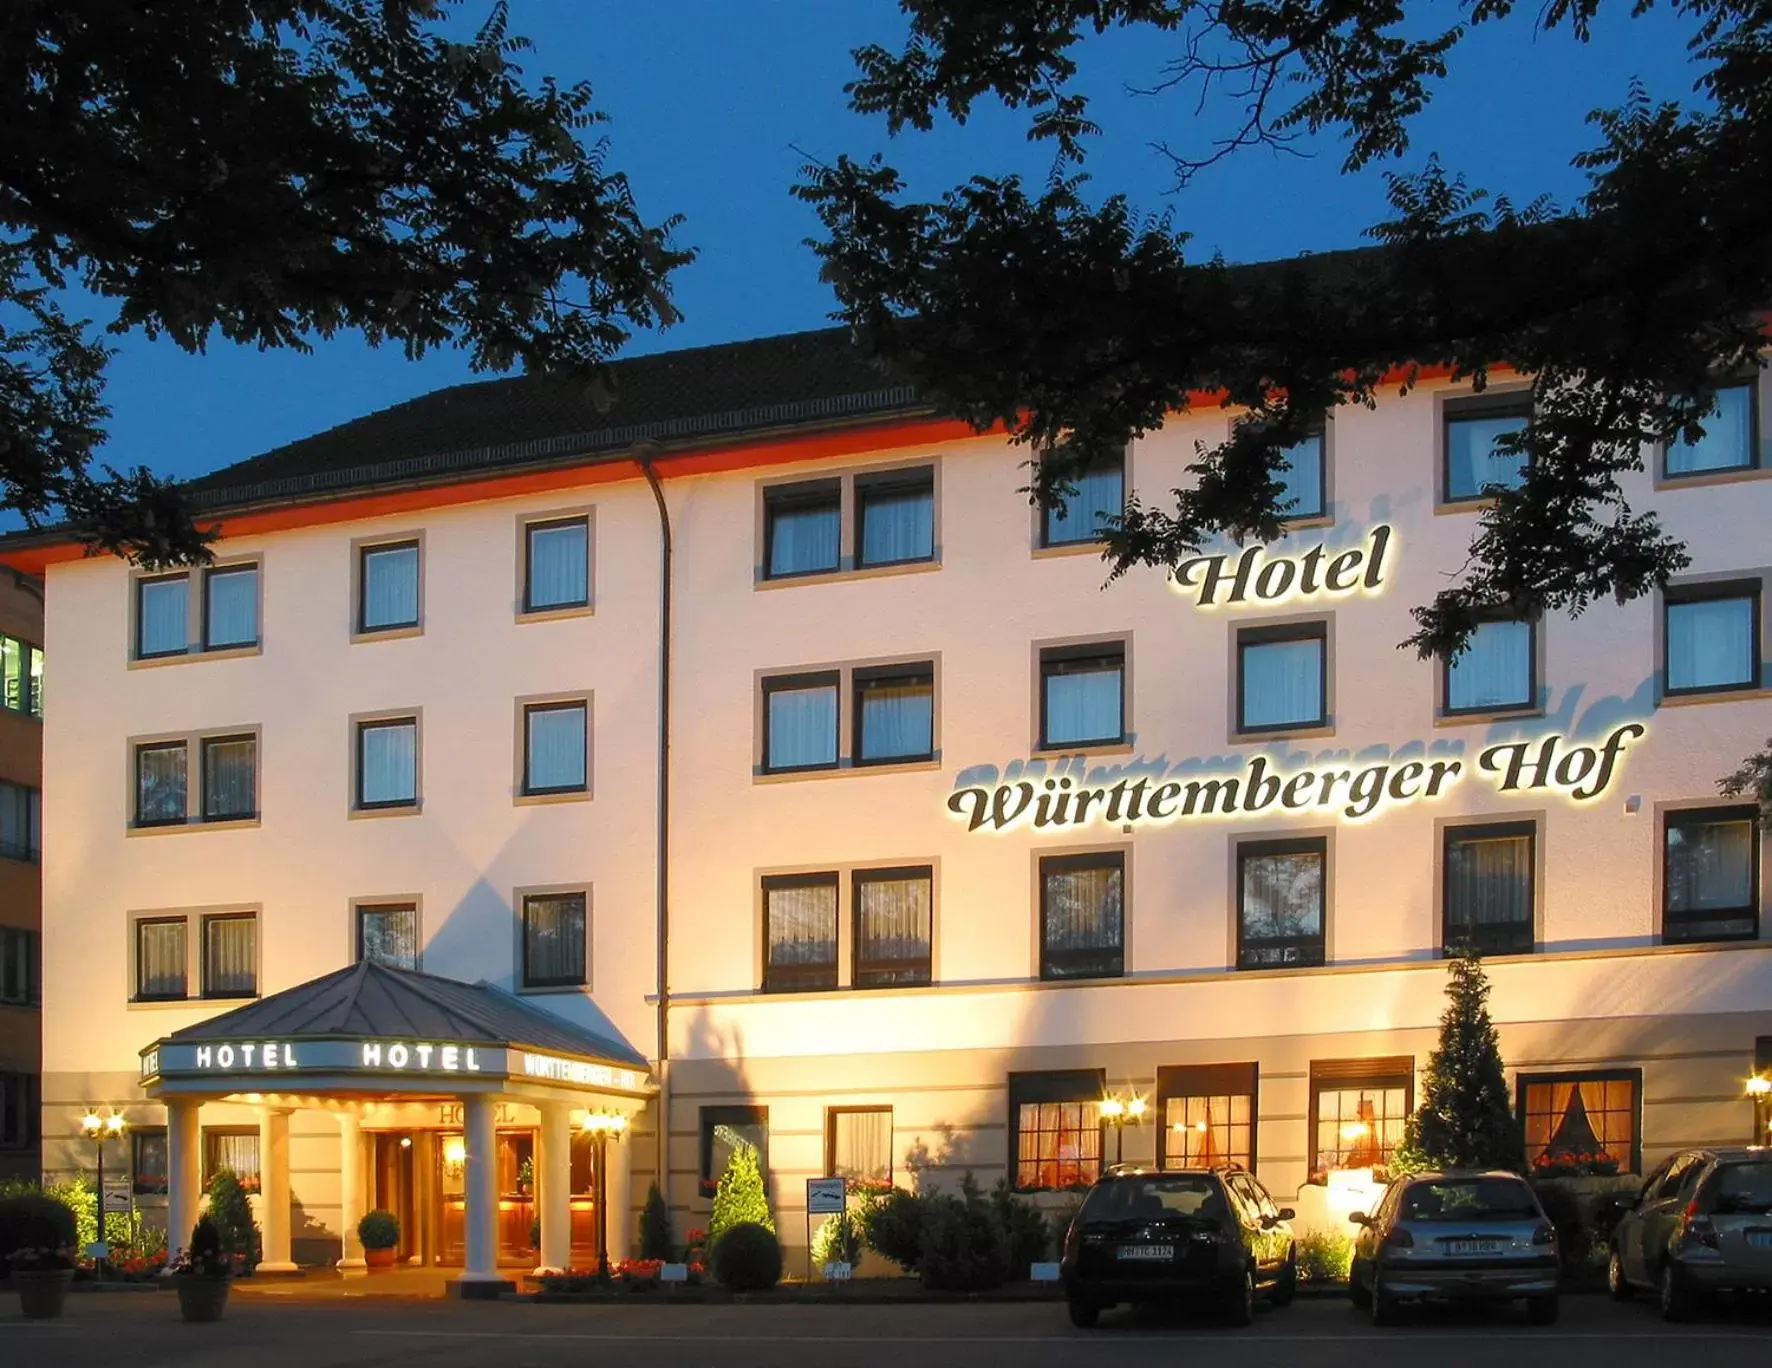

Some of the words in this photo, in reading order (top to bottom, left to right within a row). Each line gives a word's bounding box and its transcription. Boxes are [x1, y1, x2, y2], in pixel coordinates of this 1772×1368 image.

[1174, 524, 1391, 606] Hotel
[947, 756, 1463, 833] Württemberger
[1479, 723, 1645, 800] Hof
[196, 1043, 297, 1068] HOTEL
[363, 1043, 480, 1070] HOTEL
[439, 1102, 515, 1124] HOL
